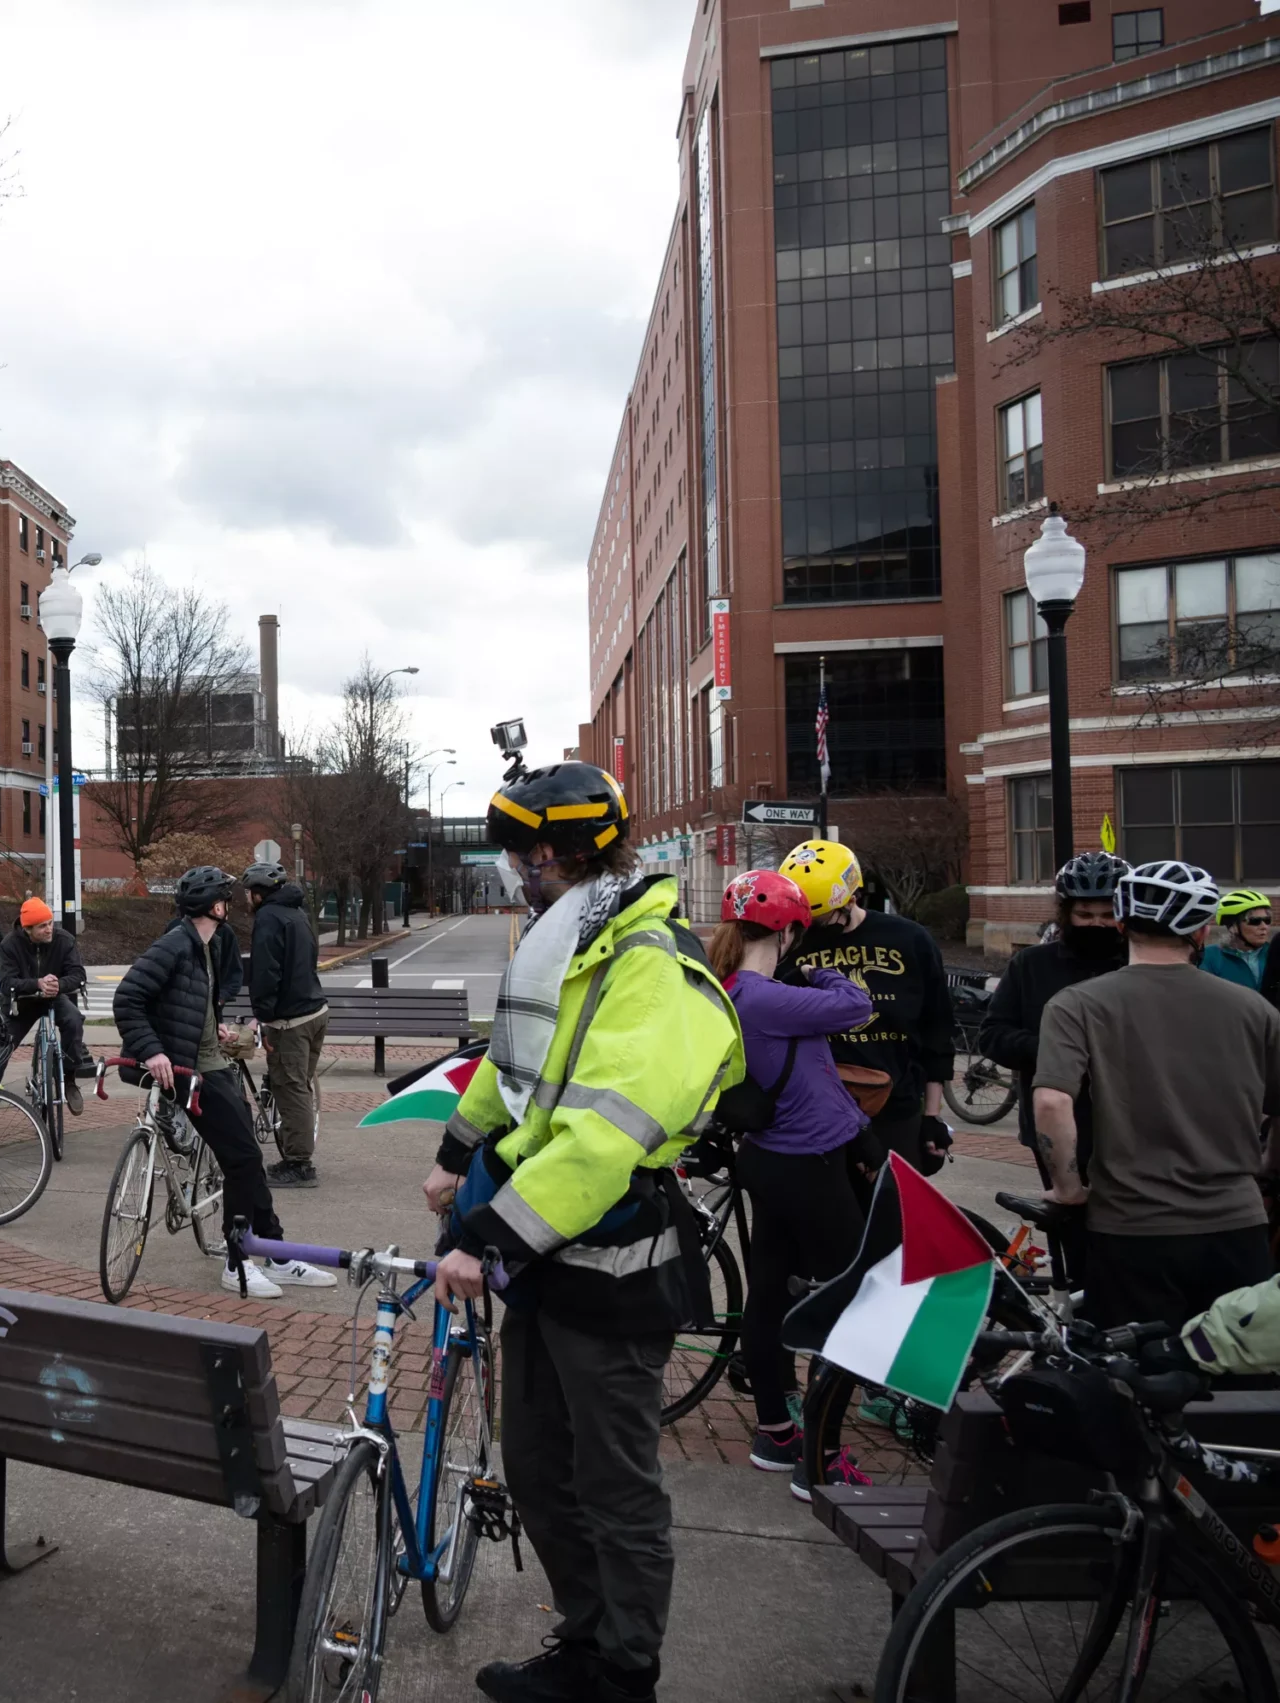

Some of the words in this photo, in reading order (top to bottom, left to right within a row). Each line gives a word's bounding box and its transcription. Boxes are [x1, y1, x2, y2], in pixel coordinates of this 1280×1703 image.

[718, 615, 726, 684] EMERGENCY
[766, 808, 787, 819] ONE
[789, 809, 811, 819] WAY
[827, 1031, 908, 1043] ITTSBURGH
